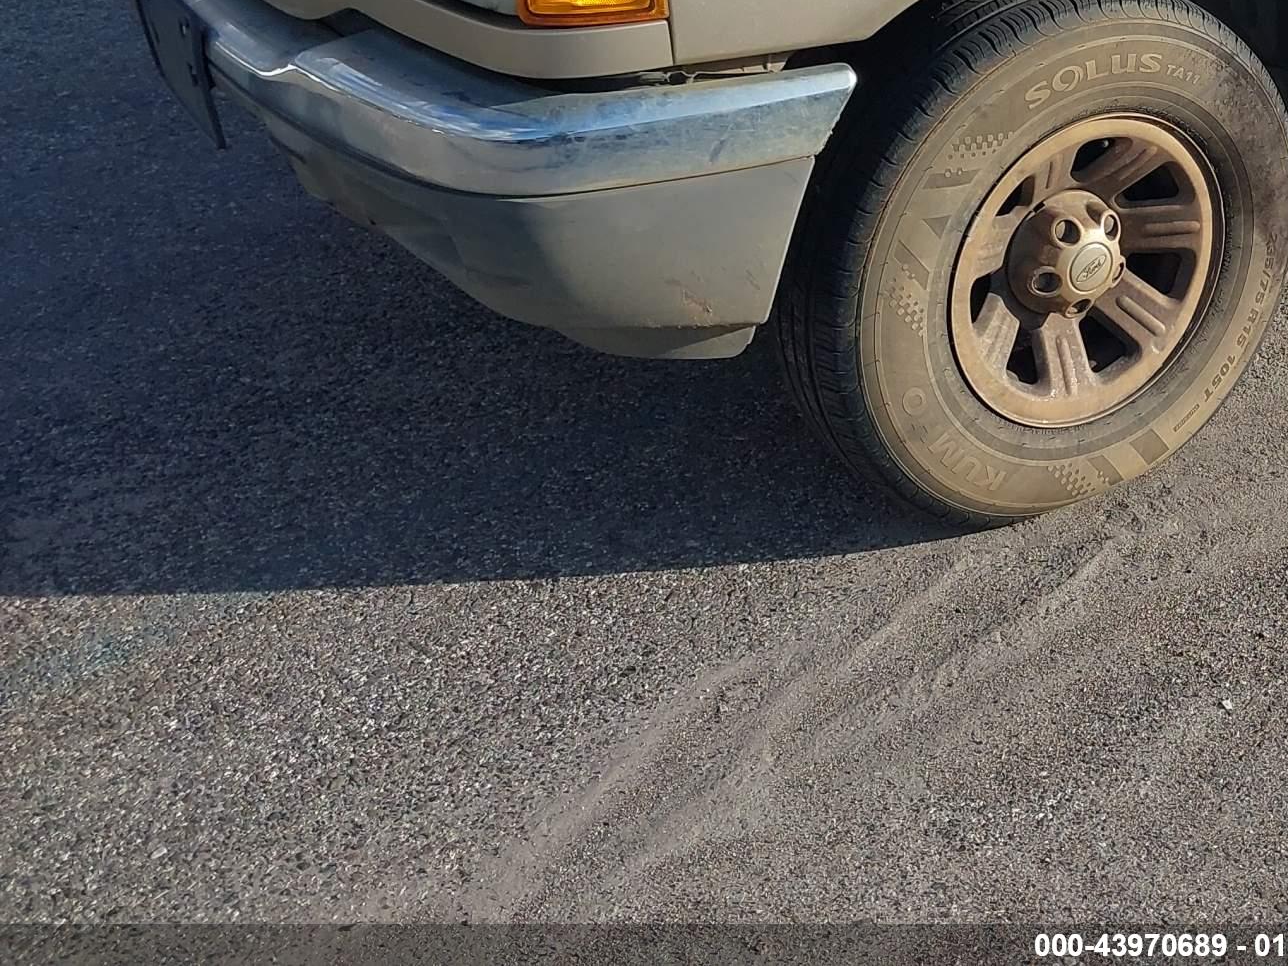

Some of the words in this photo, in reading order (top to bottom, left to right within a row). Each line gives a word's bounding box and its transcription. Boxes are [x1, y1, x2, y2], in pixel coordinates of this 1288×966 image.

[1024, 52, 1163, 110] SOLUS
[1165, 63, 1201, 85] TA11
[1203, 353, 1237, 403] 105T
